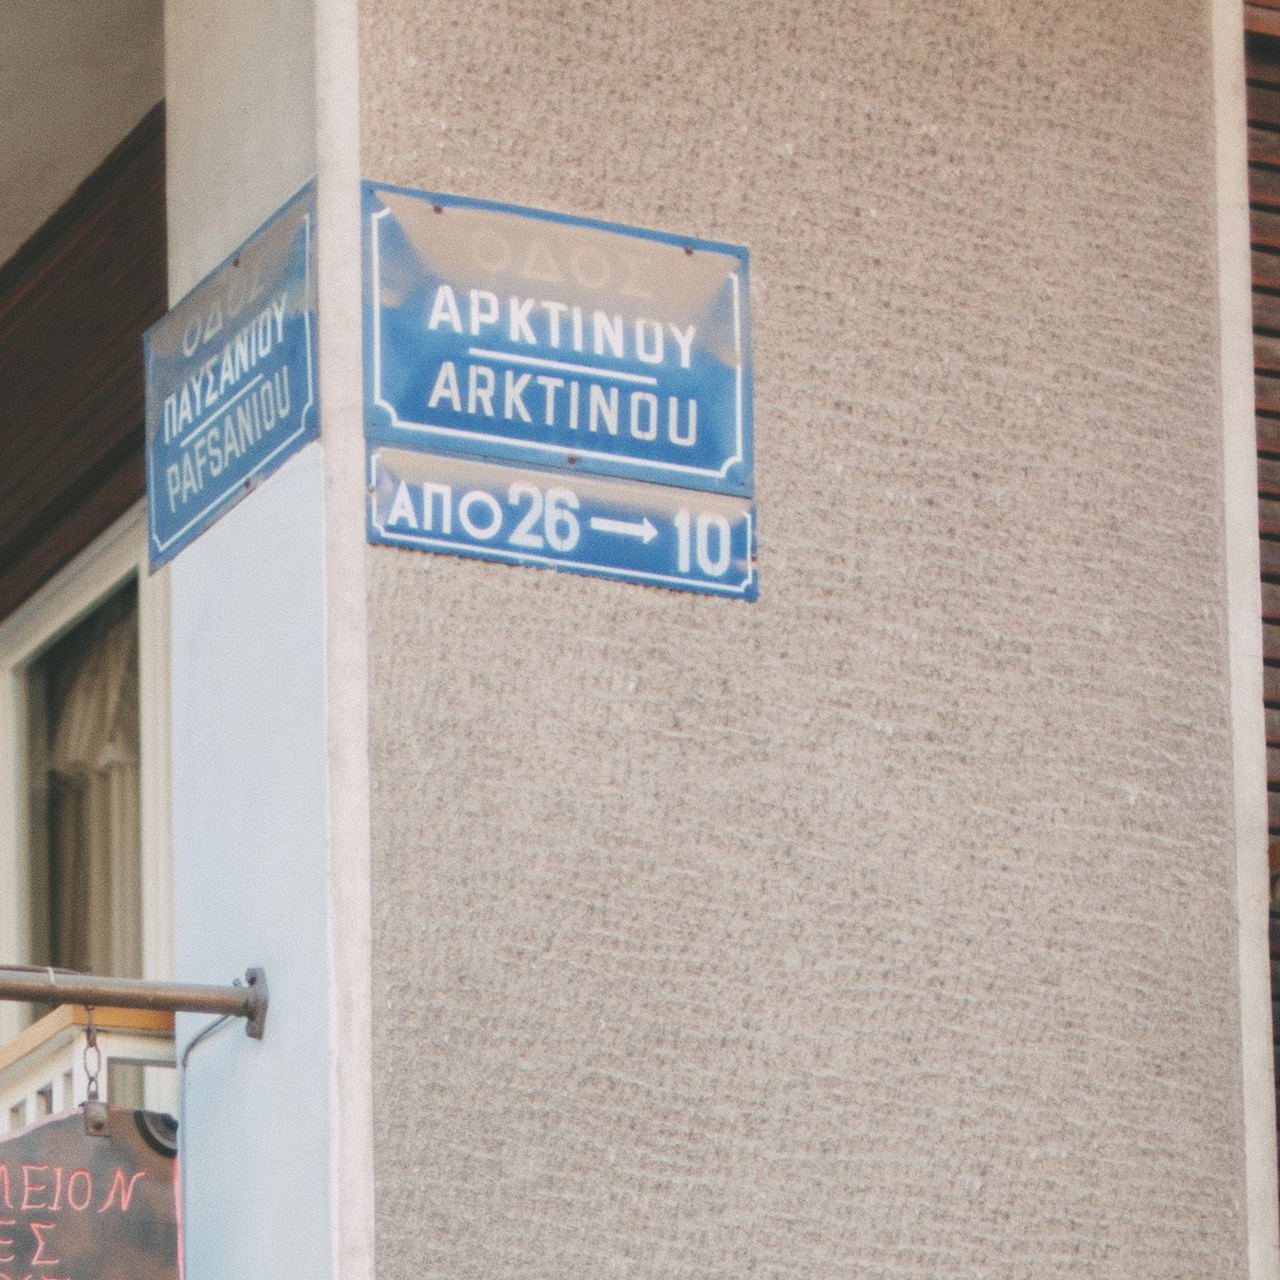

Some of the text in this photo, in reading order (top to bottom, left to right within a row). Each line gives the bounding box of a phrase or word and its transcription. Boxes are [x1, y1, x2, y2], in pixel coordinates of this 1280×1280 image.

[163, 293, 287, 446] ΠΑΥΣΑΝΙΟΥ
[427, 284, 697, 369] ΑΡΚΤΙΝΟΥ
[166, 365, 292, 514] PAFSANIOU
[427, 361, 698, 447] ARKTINOU
[386, 480, 732, 577] ΑΠΟ 26 10
